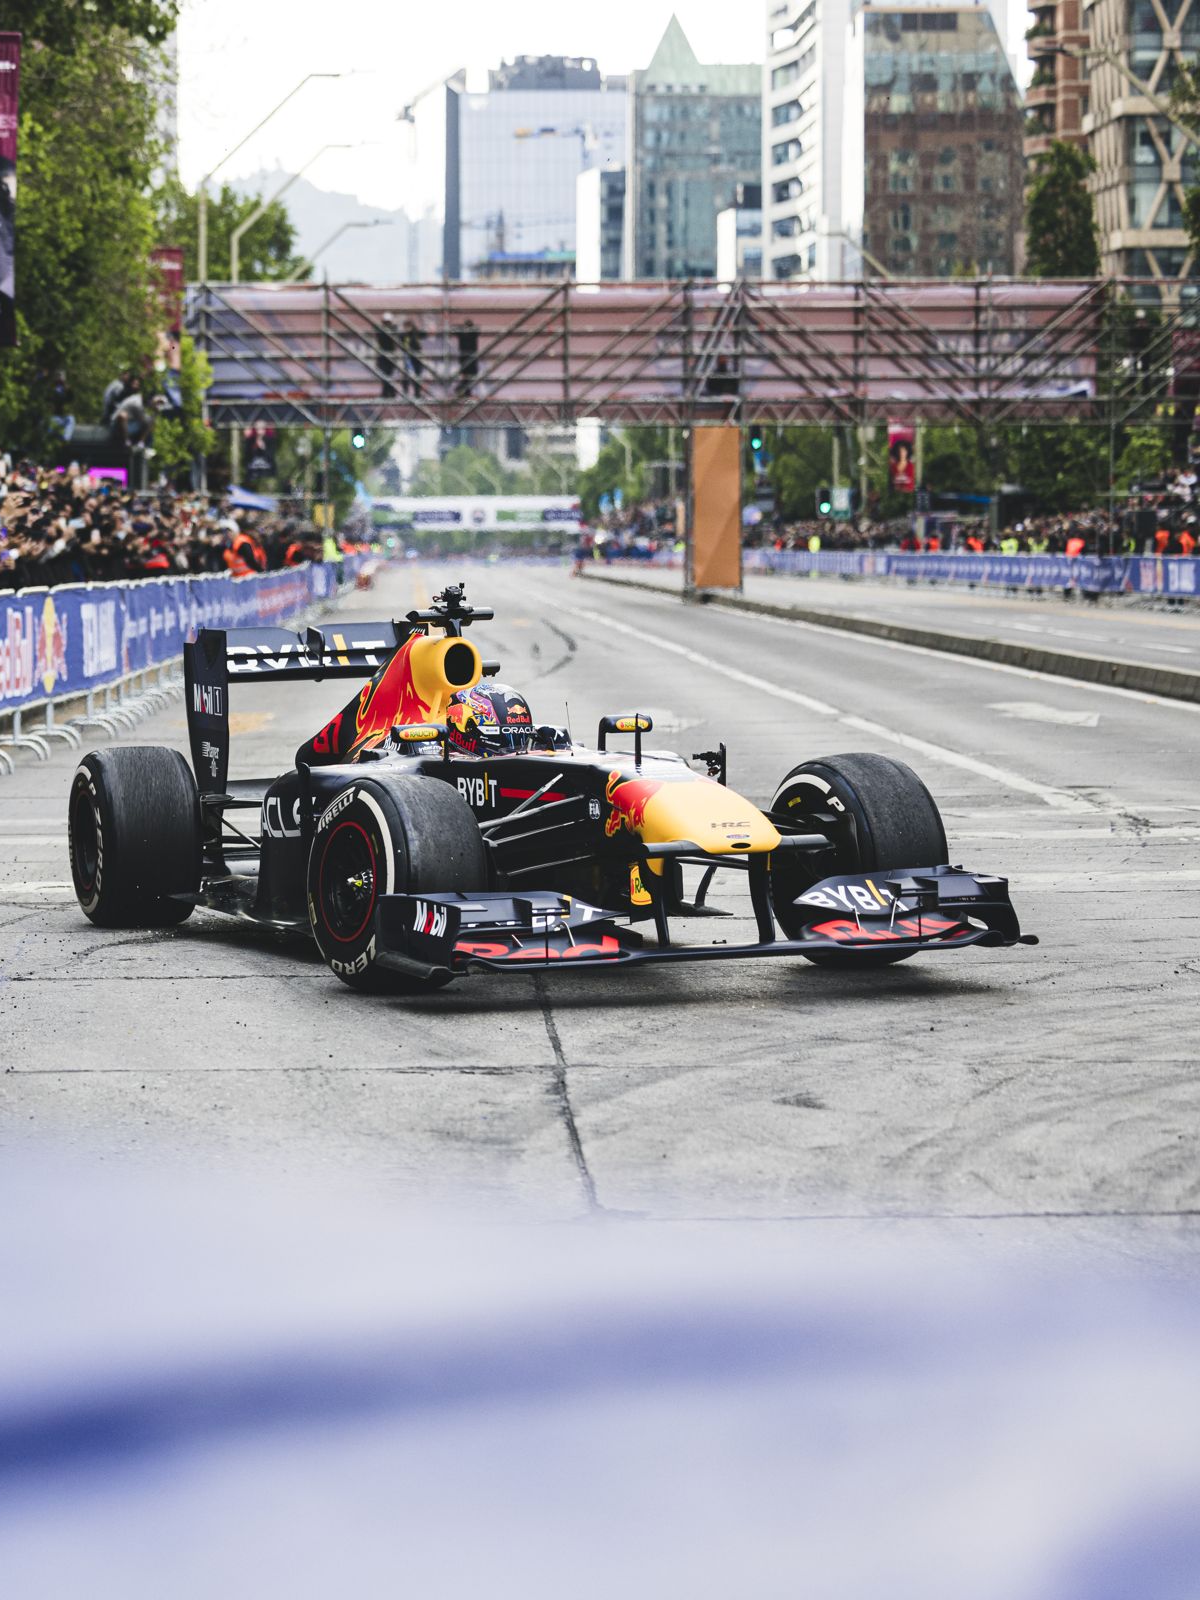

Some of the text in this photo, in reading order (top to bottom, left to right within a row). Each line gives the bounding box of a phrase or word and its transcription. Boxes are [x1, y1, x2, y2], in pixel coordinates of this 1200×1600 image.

[457, 772, 498, 808] BYBIT
[711, 821, 751, 829] HRC
[413, 900, 448, 938] Mobil
